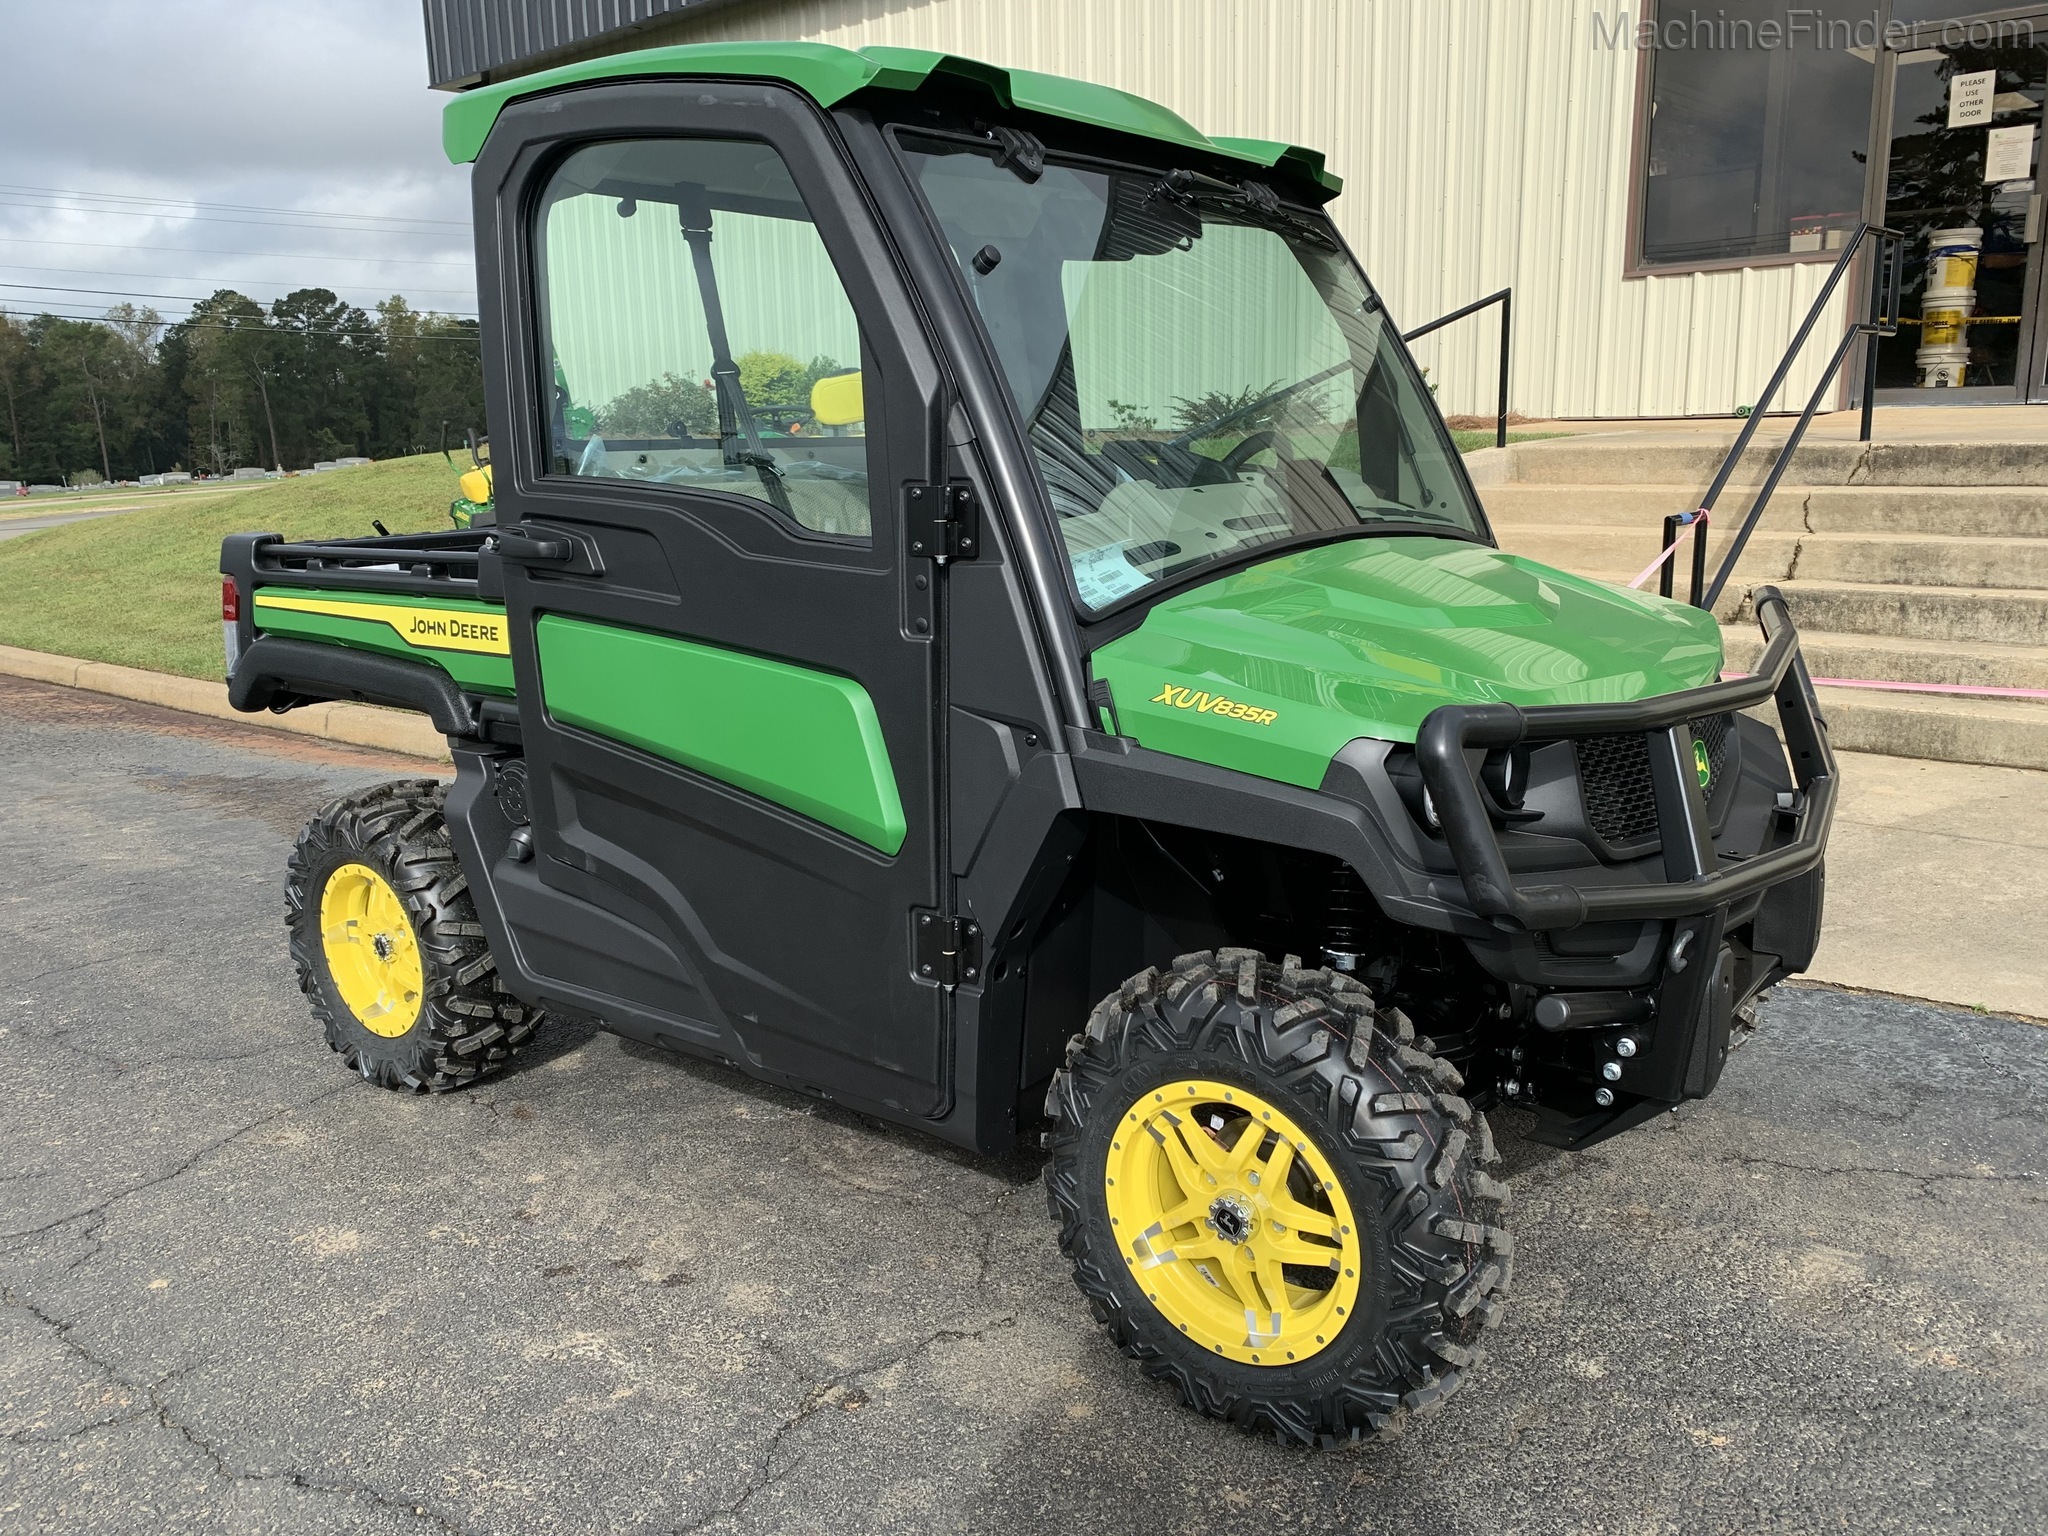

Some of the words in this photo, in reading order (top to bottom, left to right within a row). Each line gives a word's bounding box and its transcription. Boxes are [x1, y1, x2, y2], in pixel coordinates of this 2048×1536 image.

[1960, 77, 1986, 87] PLEASE
[1965, 89, 1979, 97] USE
[1959, 98, 1984, 108] OTHER
[1959, 109, 1982, 118] DOOR
[410, 616, 447, 636] JOHN
[450, 619, 499, 641] DEERE
[1148, 682, 1278, 726] XUV835R
